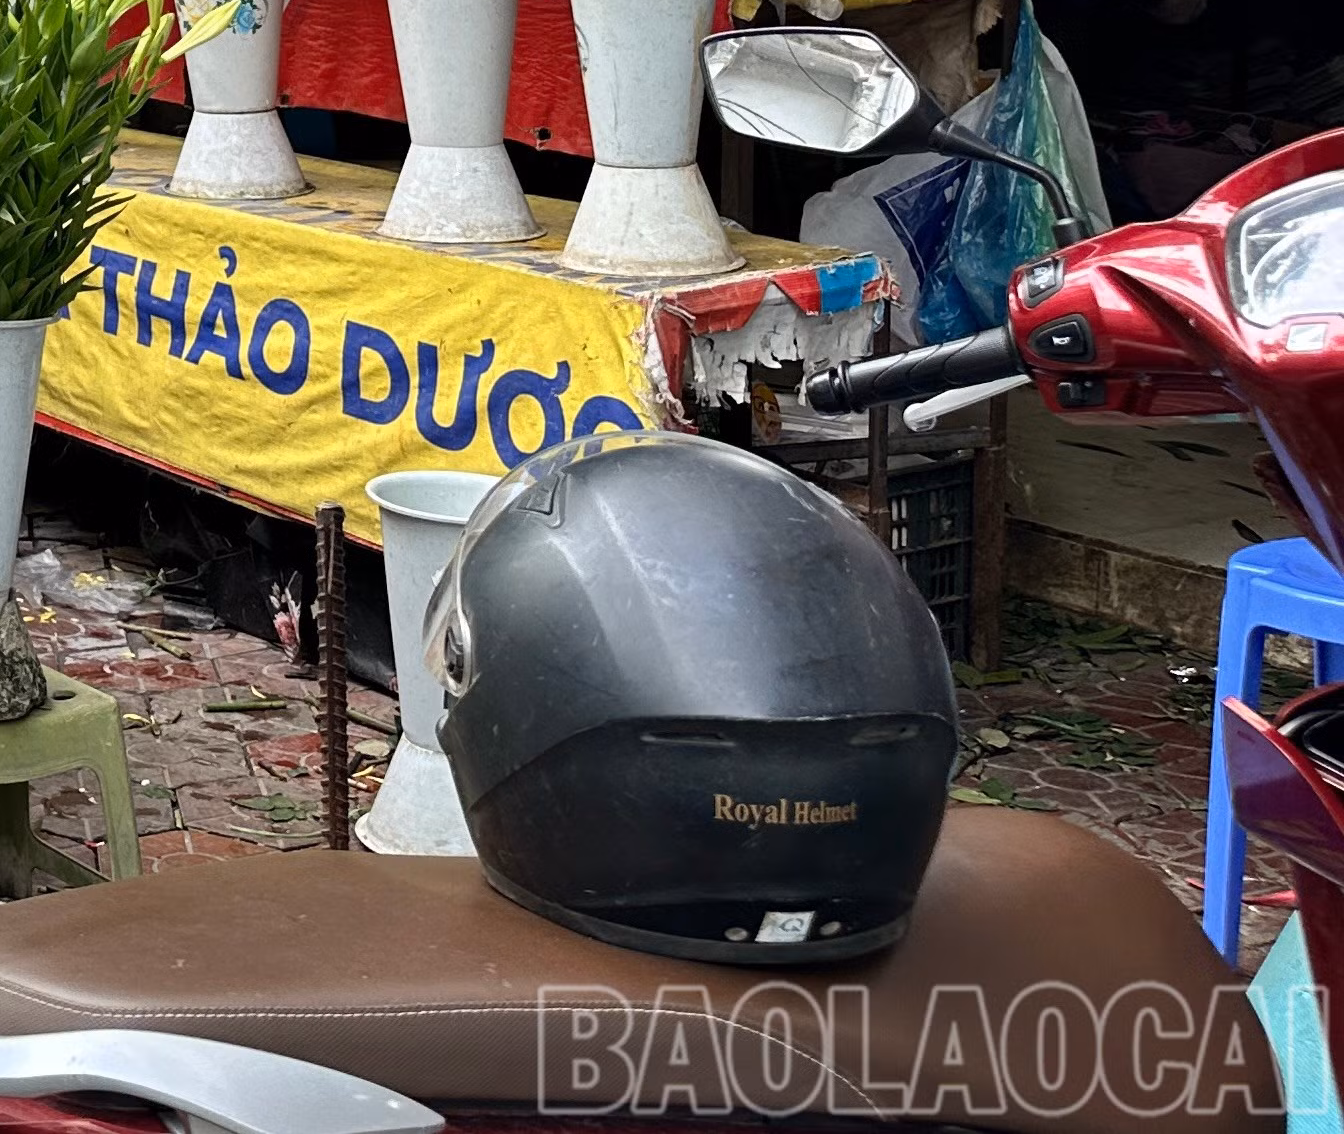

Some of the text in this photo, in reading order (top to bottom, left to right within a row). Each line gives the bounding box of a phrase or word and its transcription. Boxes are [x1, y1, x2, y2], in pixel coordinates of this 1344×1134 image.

[89, 245, 311, 396] THẢO
[713, 793, 858, 830] Royal Helmet
